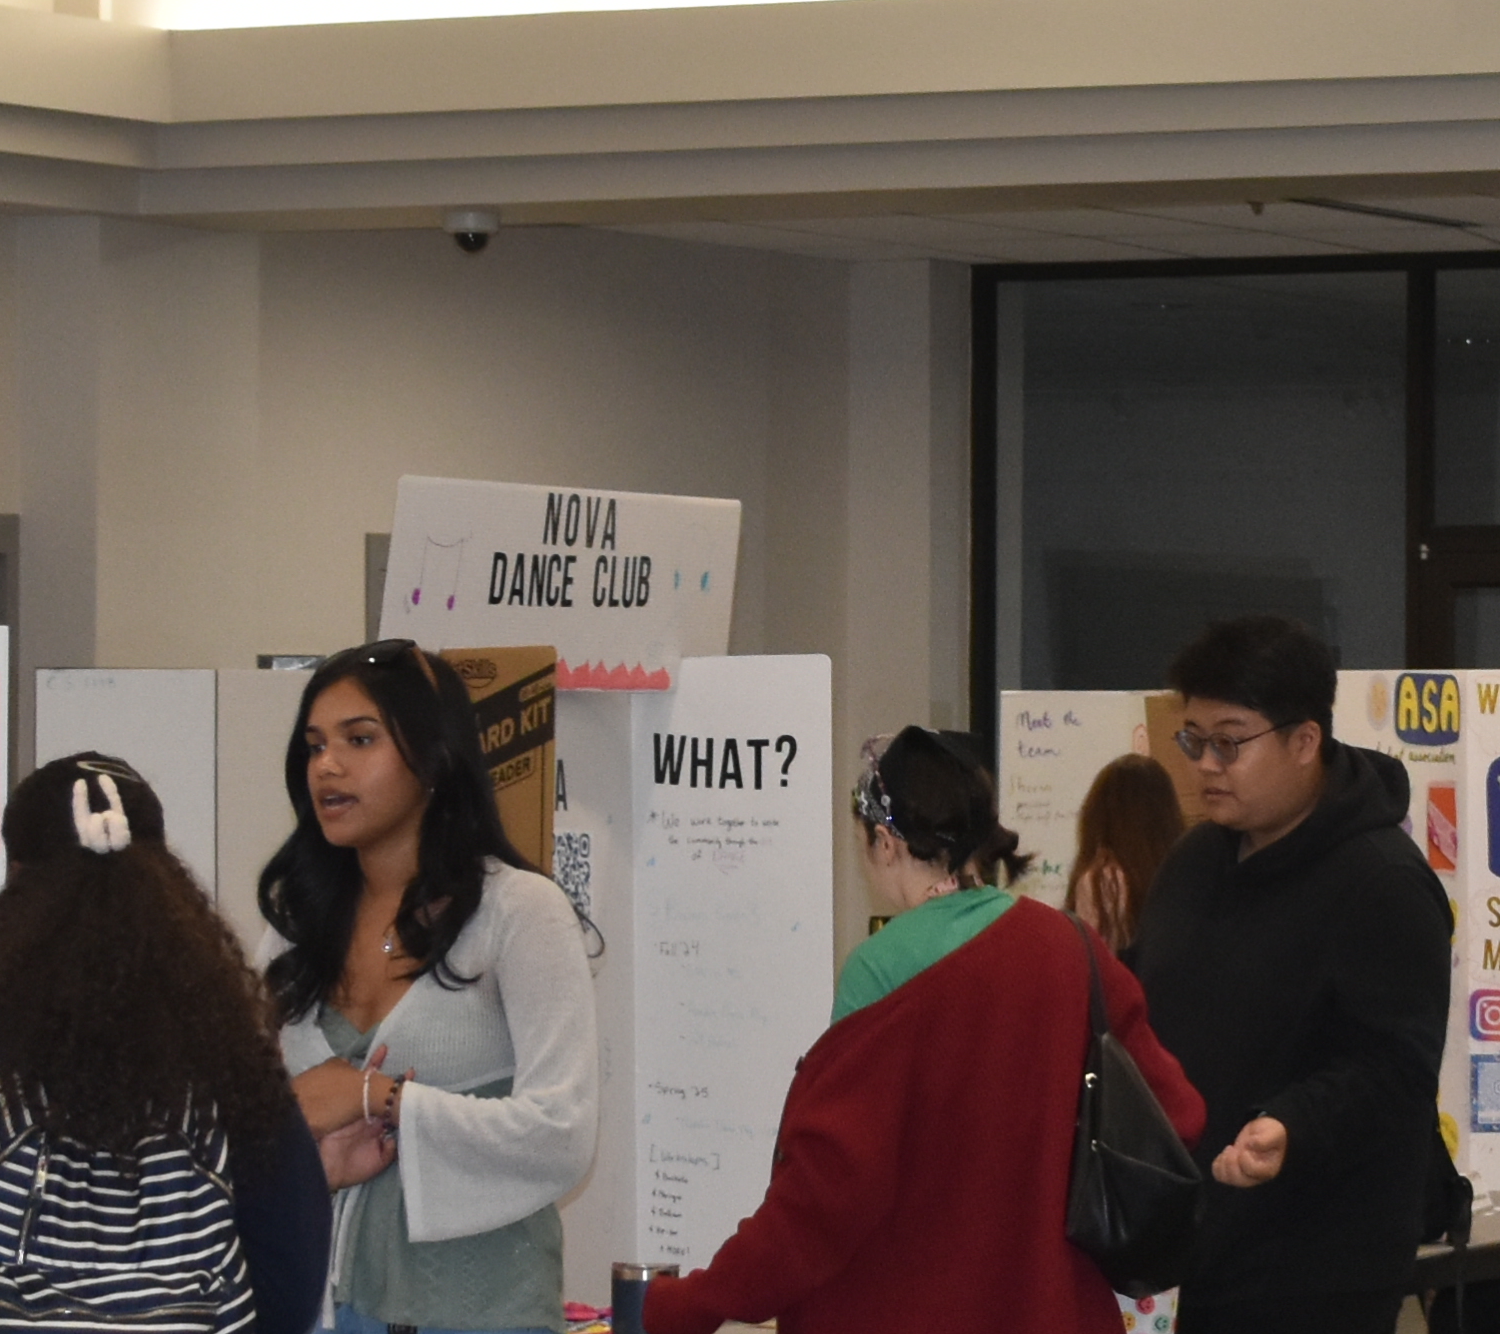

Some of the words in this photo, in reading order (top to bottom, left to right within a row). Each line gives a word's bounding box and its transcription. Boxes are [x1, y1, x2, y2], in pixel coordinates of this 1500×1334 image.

[543, 492, 616, 550] NOVA
[488, 551, 577, 607] DANCE
[593, 554, 652, 608] CLUB
[520, 695, 552, 736] KIT
[1016, 710, 1053, 731] Meet
[1397, 676, 1460, 733] ASA
[653, 732, 798, 791] WHAT?
[1018, 740, 1060, 758] team
